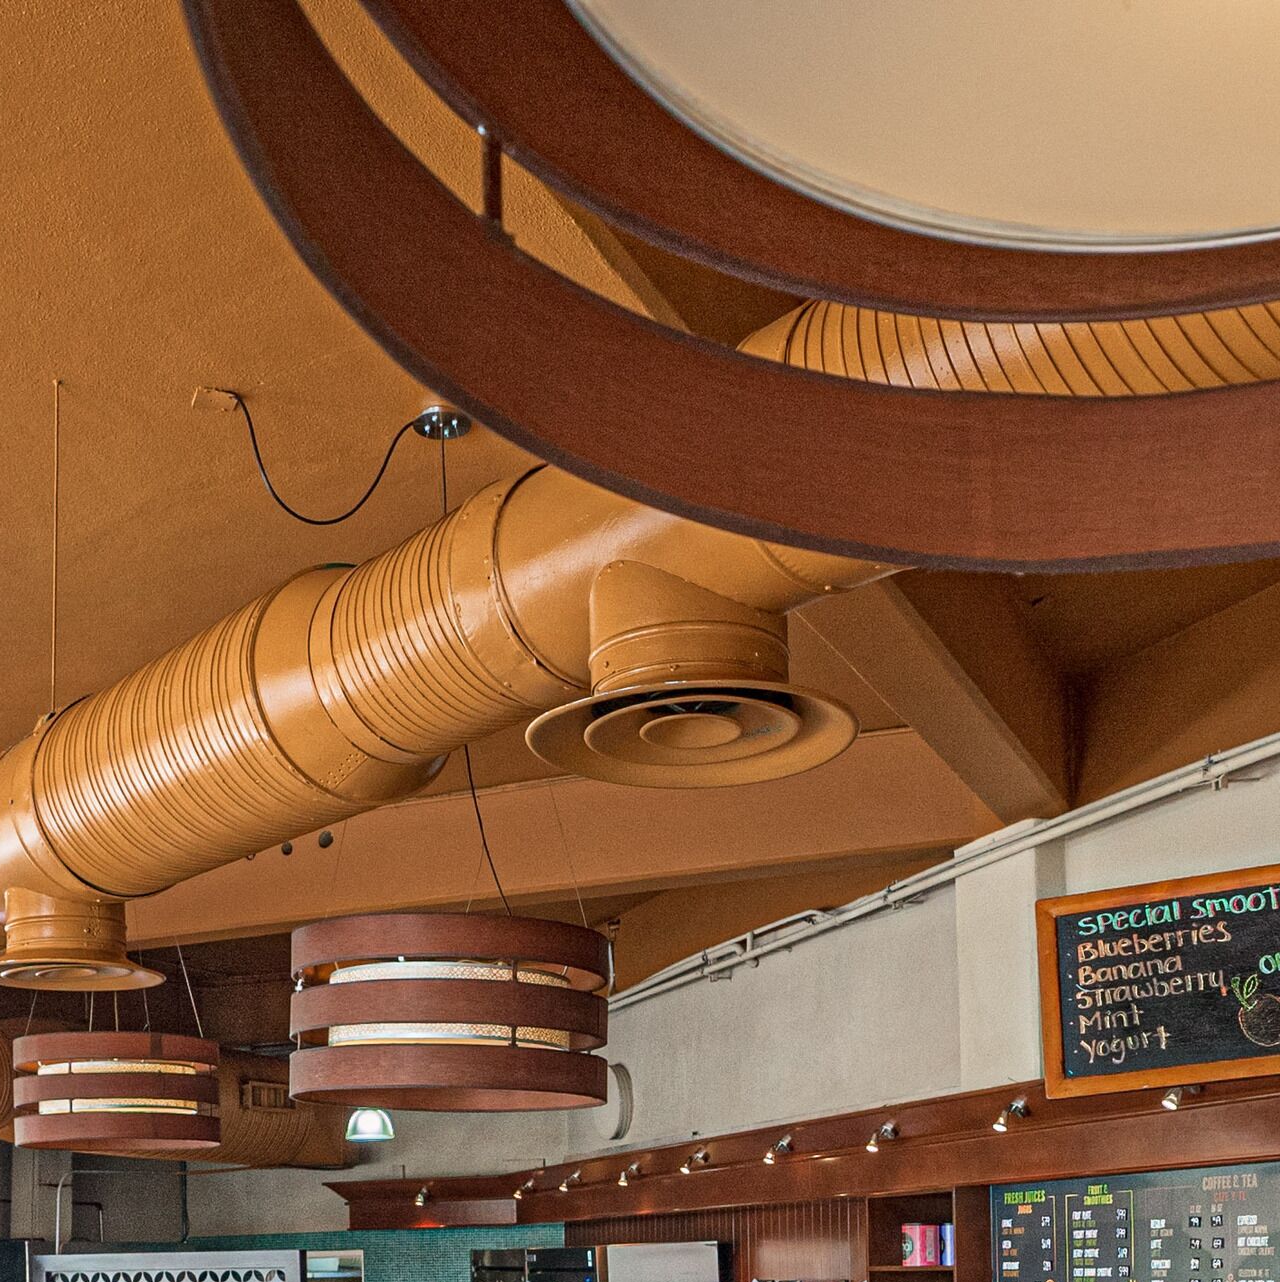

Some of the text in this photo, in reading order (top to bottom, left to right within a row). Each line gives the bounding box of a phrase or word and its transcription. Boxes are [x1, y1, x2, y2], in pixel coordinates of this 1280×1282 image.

[1077, 921, 1232, 963] Blueberries
[1078, 955, 1182, 986] Banana
[1079, 1003, 1144, 1034] Mint
[1004, 1192, 1023, 1204] FRESH
[1202, 1175, 1232, 1191] COFFEE
[1242, 1174, 1258, 1188] TEA
